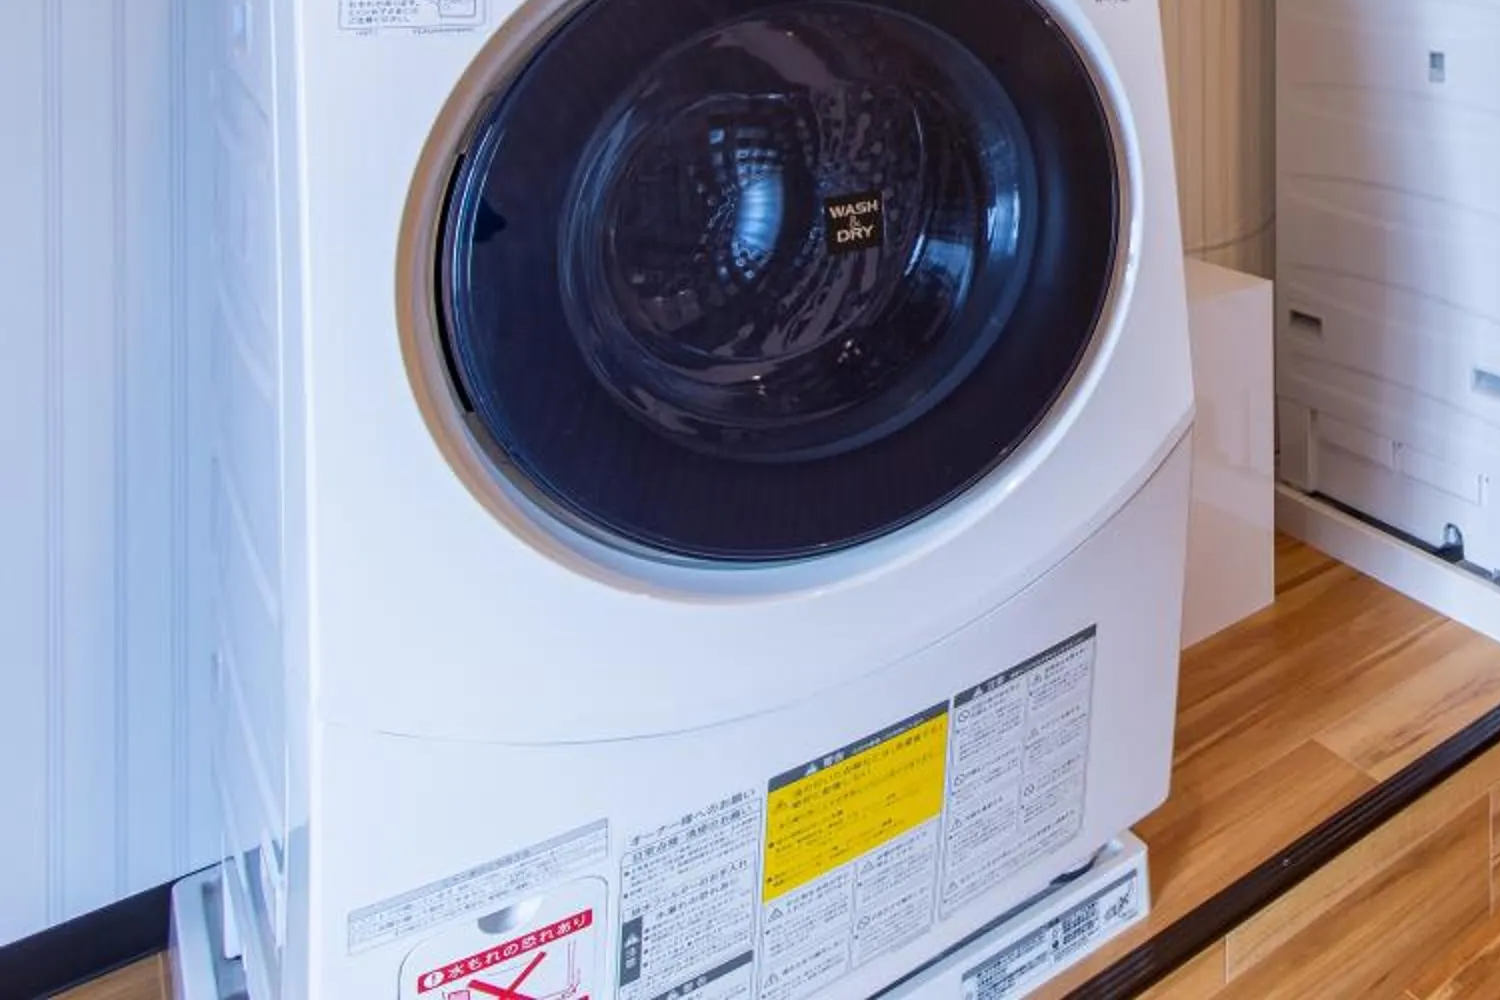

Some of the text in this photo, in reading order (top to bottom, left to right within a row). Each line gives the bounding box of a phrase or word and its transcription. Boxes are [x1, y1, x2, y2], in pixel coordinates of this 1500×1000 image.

[829, 199, 878, 218] WASH
[837, 224, 875, 243] DRY
[447, 913, 586, 979] 水もれの恐れあり
